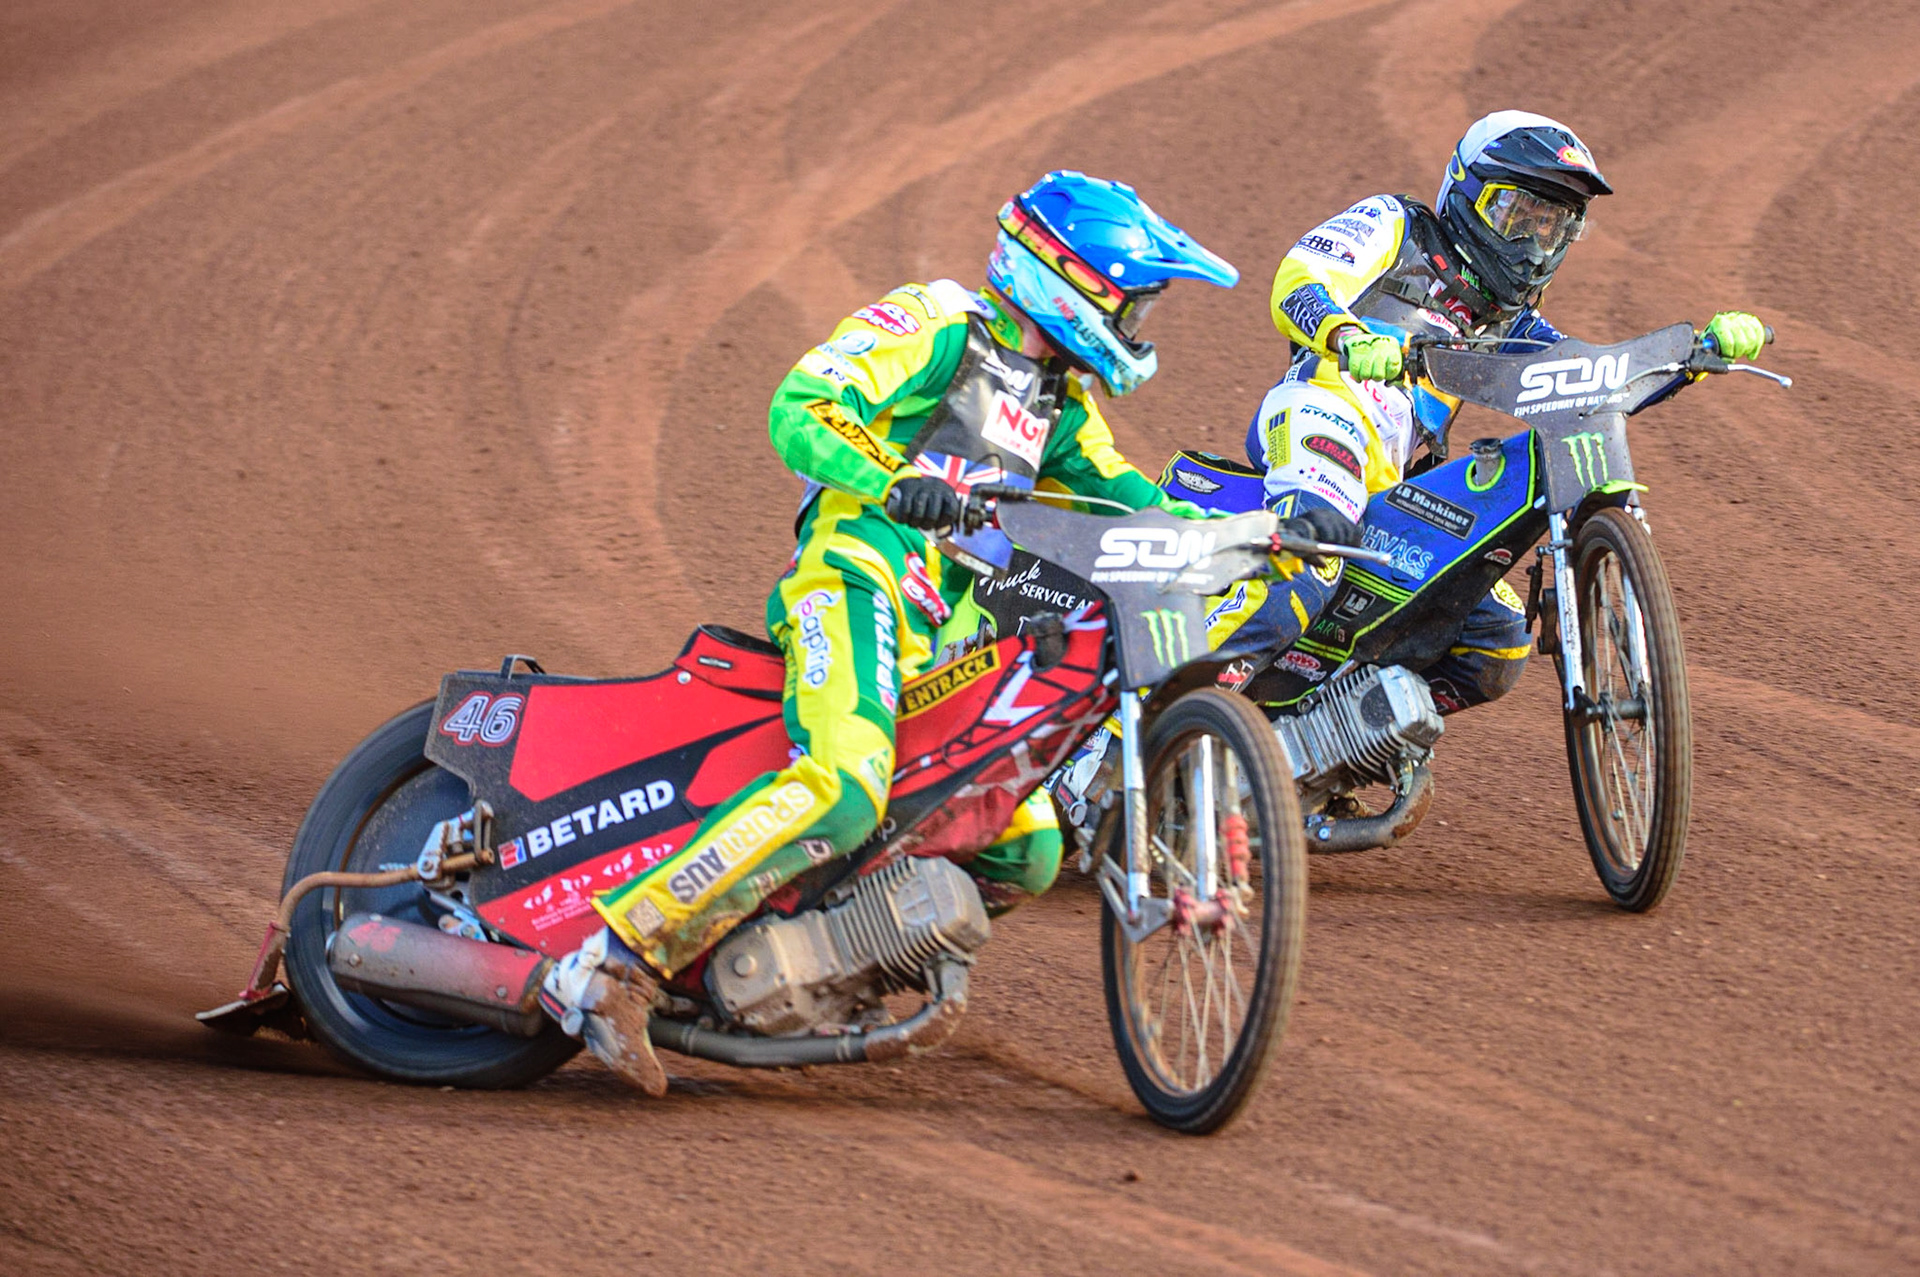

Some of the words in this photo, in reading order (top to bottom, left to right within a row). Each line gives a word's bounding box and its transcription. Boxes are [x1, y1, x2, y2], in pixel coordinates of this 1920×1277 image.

[1281, 292, 1320, 338] CARS
[1531, 398, 1574, 414] SPEEDWAY
[1395, 484, 1411, 499] LB
[1412, 491, 1470, 527] Maskiner
[1362, 524, 1434, 573] HVACS
[1019, 583, 1076, 610] SERVICE
[442, 693, 523, 745] 46
[526, 779, 676, 858] BETARD
